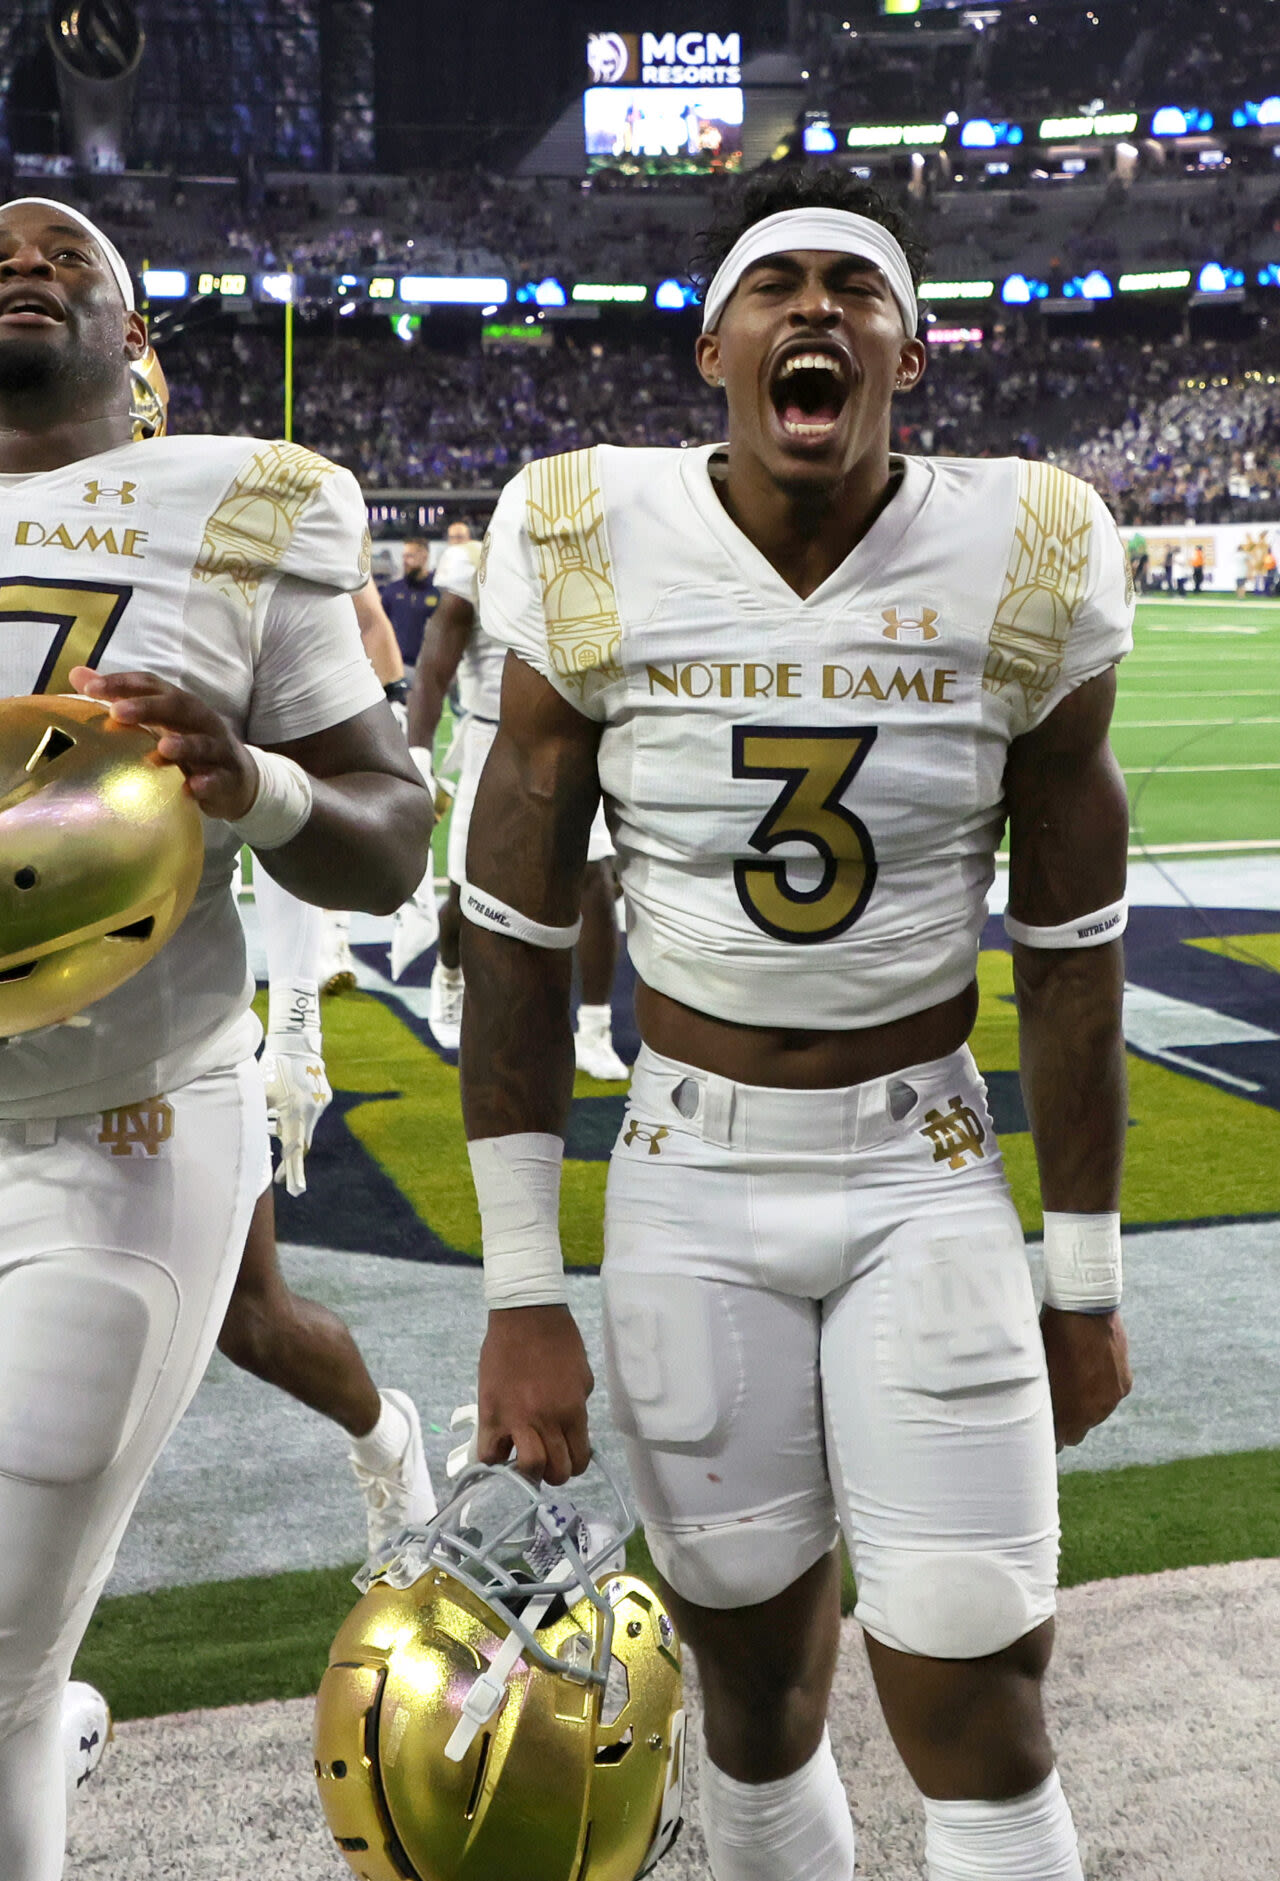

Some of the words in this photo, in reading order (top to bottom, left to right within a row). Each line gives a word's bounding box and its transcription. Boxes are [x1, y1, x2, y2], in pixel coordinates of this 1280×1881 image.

[641, 32, 740, 65] MGM
[641, 65, 741, 84] RESORTS
[15, 521, 150, 558] DAME
[645, 662, 802, 699] NOTRE
[822, 664, 958, 703] DAME
[732, 725, 878, 944] 3
